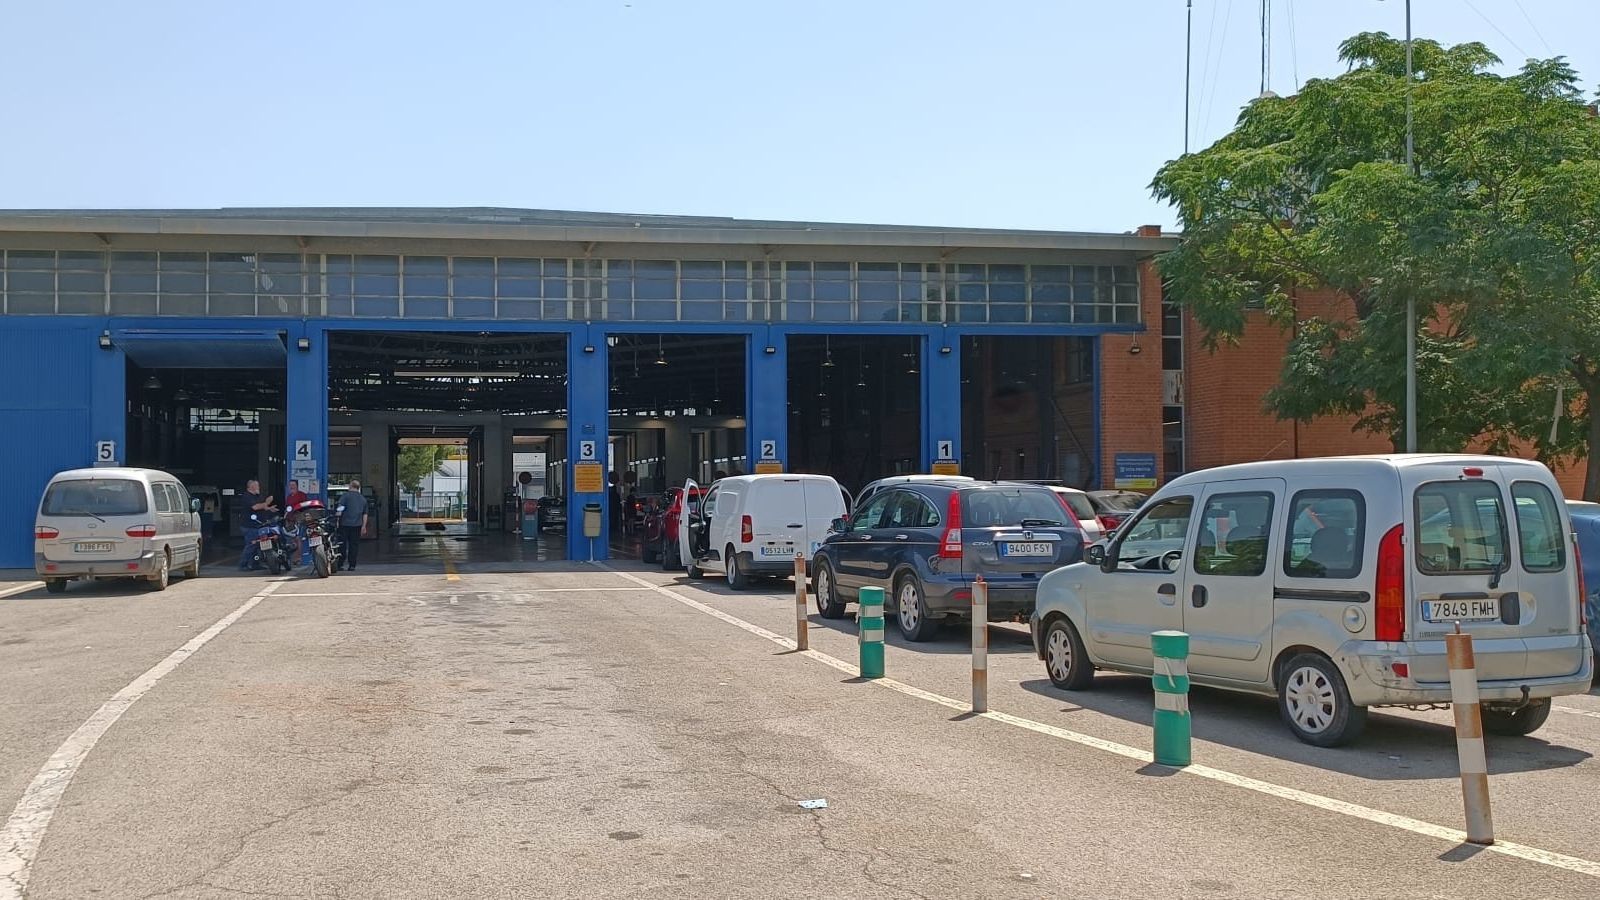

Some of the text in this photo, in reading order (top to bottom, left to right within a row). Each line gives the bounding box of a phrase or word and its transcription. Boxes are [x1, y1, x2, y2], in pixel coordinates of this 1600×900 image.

[101, 443, 112, 459] 5
[297, 444, 309, 457] 4
[583, 443, 593, 457] 3
[763, 443, 774, 457] 2
[941, 443, 949, 457] 1
[1009, 543, 1050, 553] 9400 FSY
[1433, 601, 1495, 617] 7849 FMH
